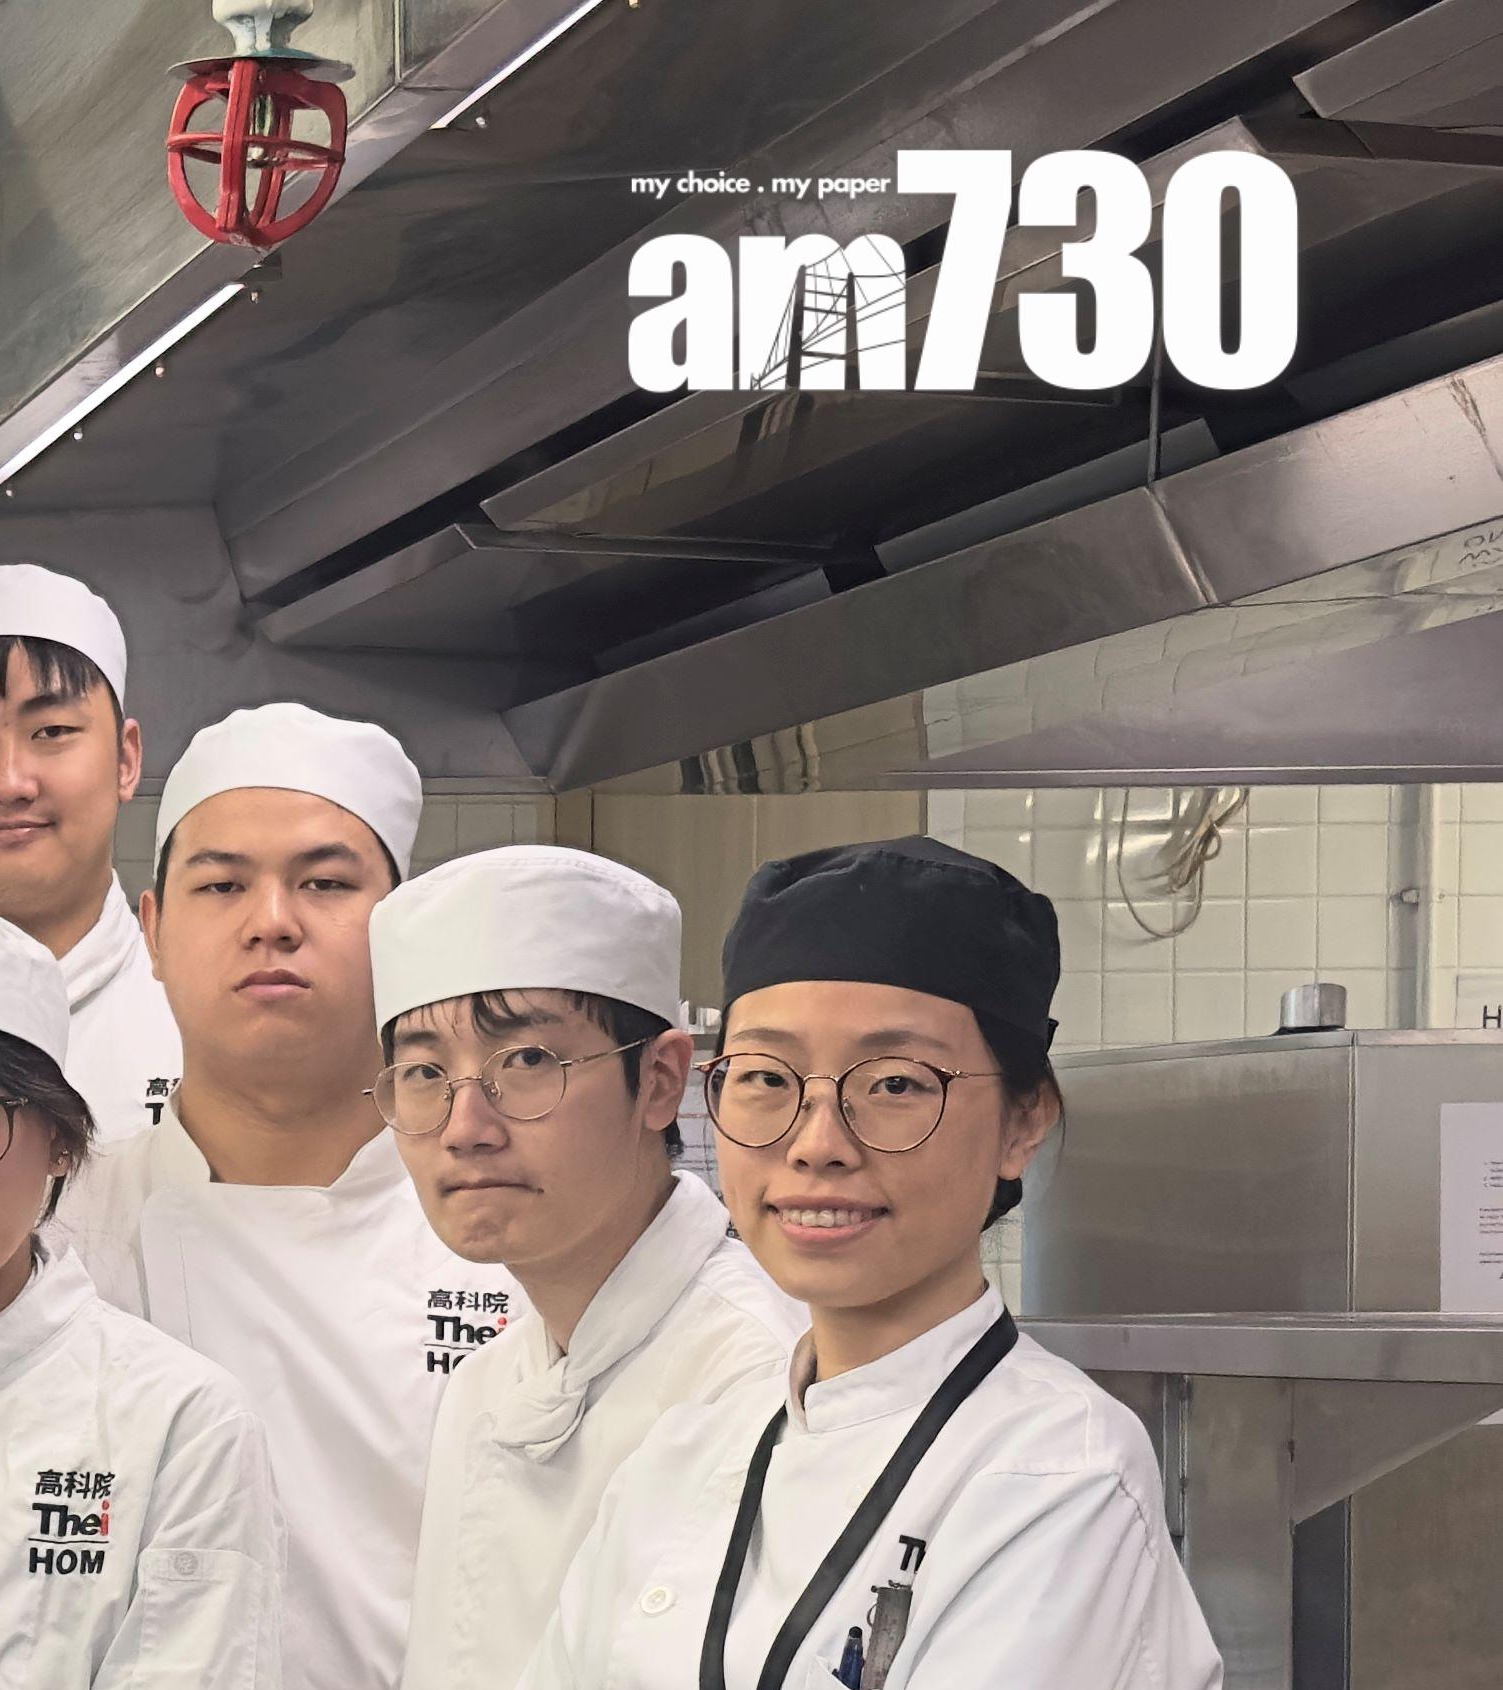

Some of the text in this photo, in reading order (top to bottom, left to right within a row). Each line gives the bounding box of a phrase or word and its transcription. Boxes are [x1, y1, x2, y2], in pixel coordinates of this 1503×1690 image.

[428, 1289, 509, 1314] 高科院
[427, 1351, 466, 1374] H
[35, 1469, 116, 1499] 高科院
[32, 1499, 110, 1537] Thei
[29, 1547, 105, 1575] HOM
